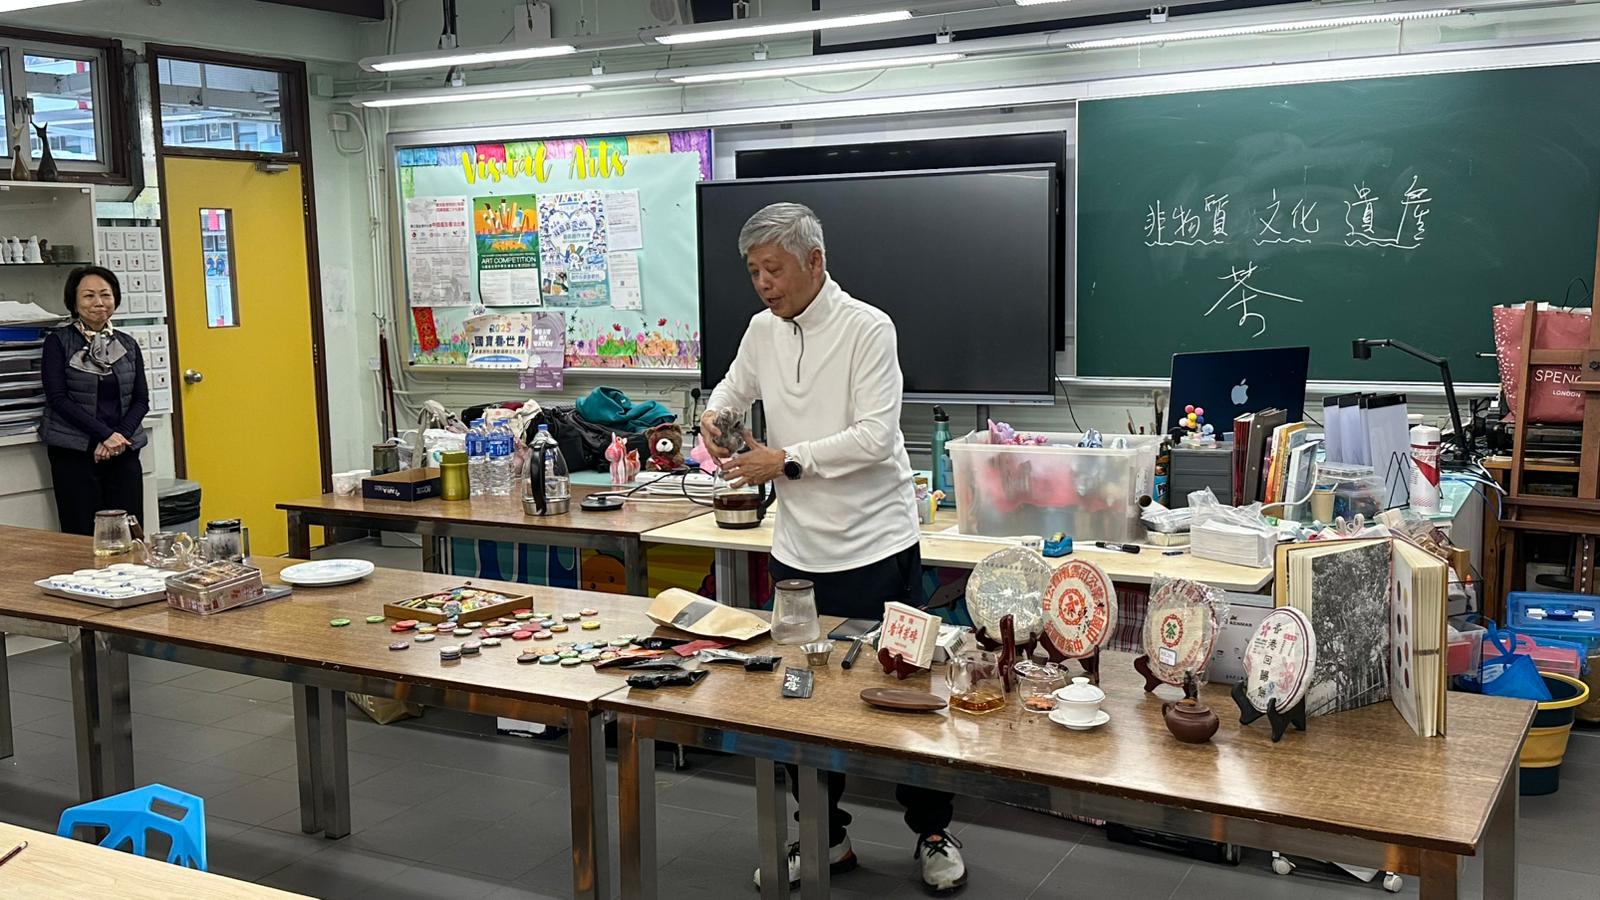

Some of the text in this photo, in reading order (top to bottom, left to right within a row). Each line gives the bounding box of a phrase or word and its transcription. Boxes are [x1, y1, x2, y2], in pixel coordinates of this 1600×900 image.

[460, 141, 628, 184] Visual Arts
[1144, 194, 1231, 241] 非物質
[1258, 188, 1320, 236] 文化
[481, 257, 493, 265] ART
[493, 256, 537, 265] COMPETITION
[489, 322, 513, 333] 2025
[534, 328, 552, 336] DRAW
[1552, 389, 1581, 398] LONDON
